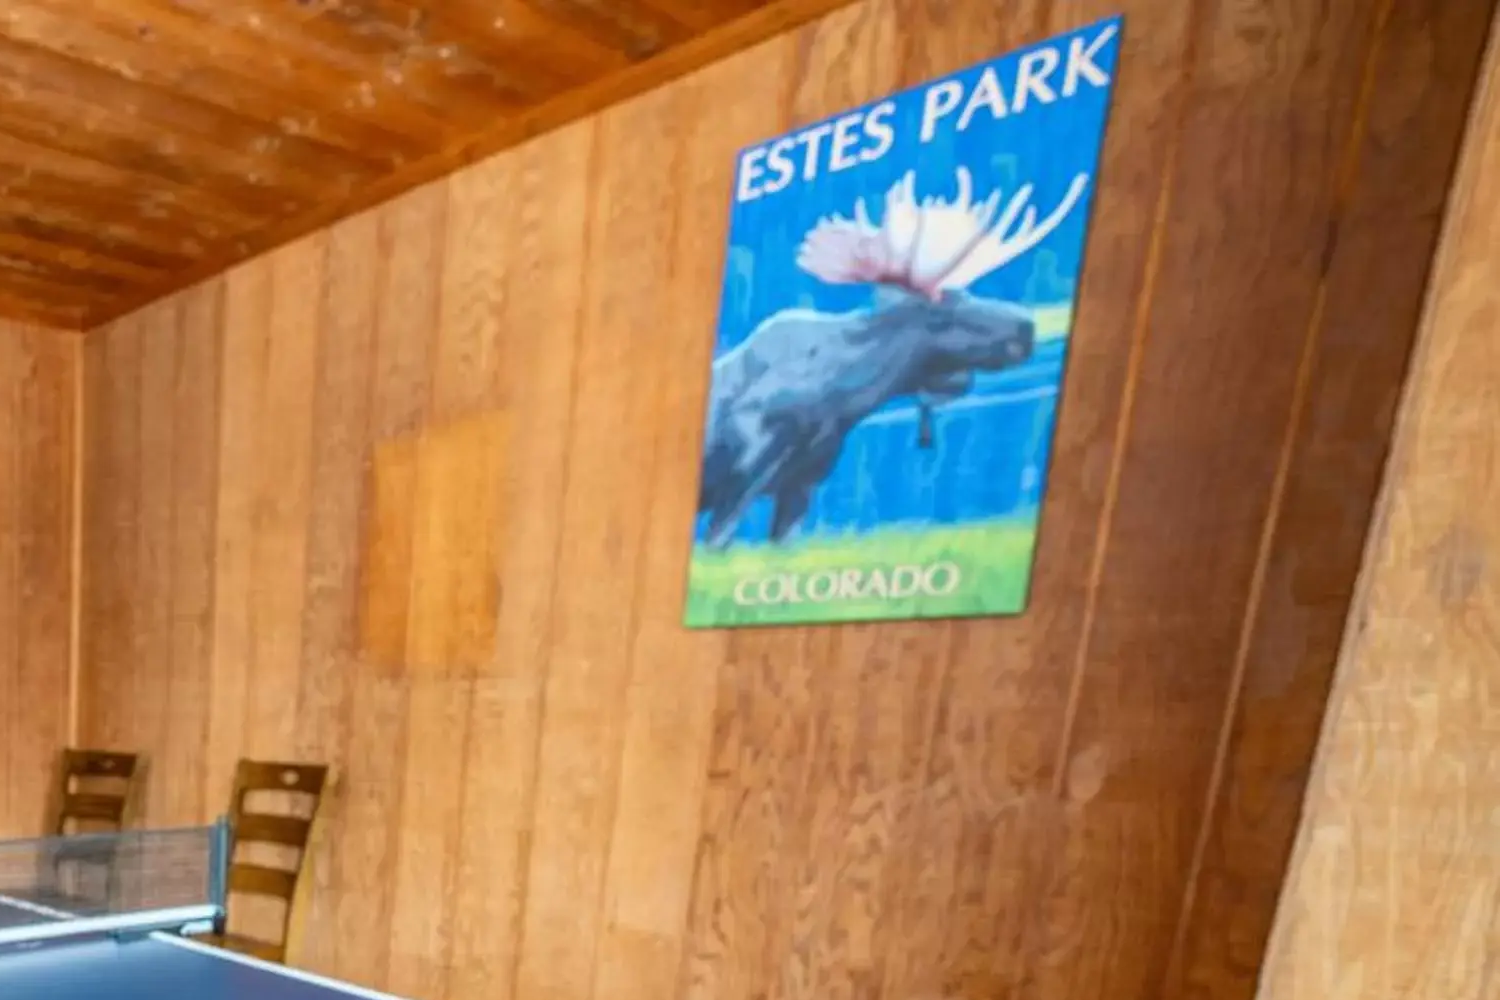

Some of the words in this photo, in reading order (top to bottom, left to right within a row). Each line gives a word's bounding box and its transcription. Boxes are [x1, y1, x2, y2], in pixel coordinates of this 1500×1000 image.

[736, 104, 896, 202] ESTES
[920, 25, 1119, 142] PARK
[735, 562, 961, 606] COLORADO
